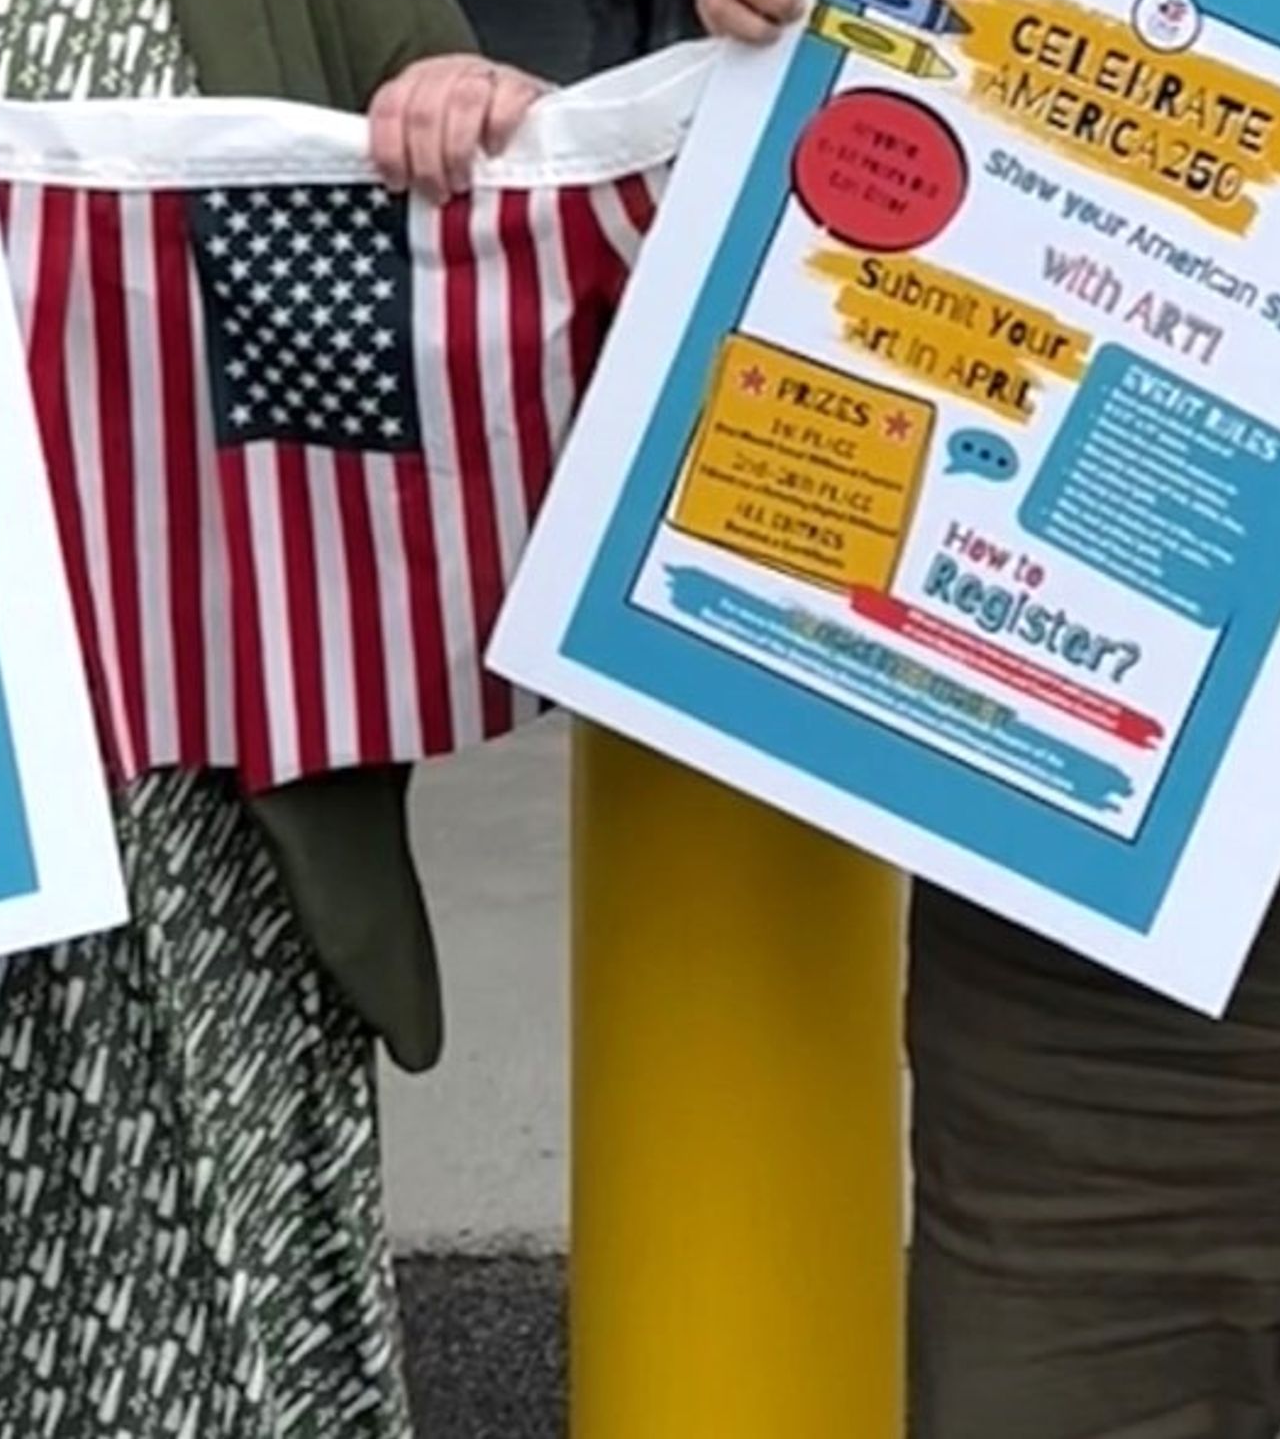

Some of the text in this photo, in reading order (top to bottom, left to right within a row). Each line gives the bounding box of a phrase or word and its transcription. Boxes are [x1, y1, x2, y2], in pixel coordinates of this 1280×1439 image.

[1011, 14, 1274, 154] CELEBRATE
[982, 66, 1245, 204] AMERICA250
[984, 147, 1056, 199] Show
[1062, 186, 1128, 238] your
[1129, 220, 1258, 302] American
[856, 257, 1070, 361] Submit Your
[1040, 245, 1124, 321] with
[776, 377, 870, 428] PRIZES
[848, 317, 1038, 416] Art in APRIL
[1122, 363, 1280, 462] EVENT RULES
[943, 520, 1045, 588] How to
[923, 551, 1142, 683] Register?
